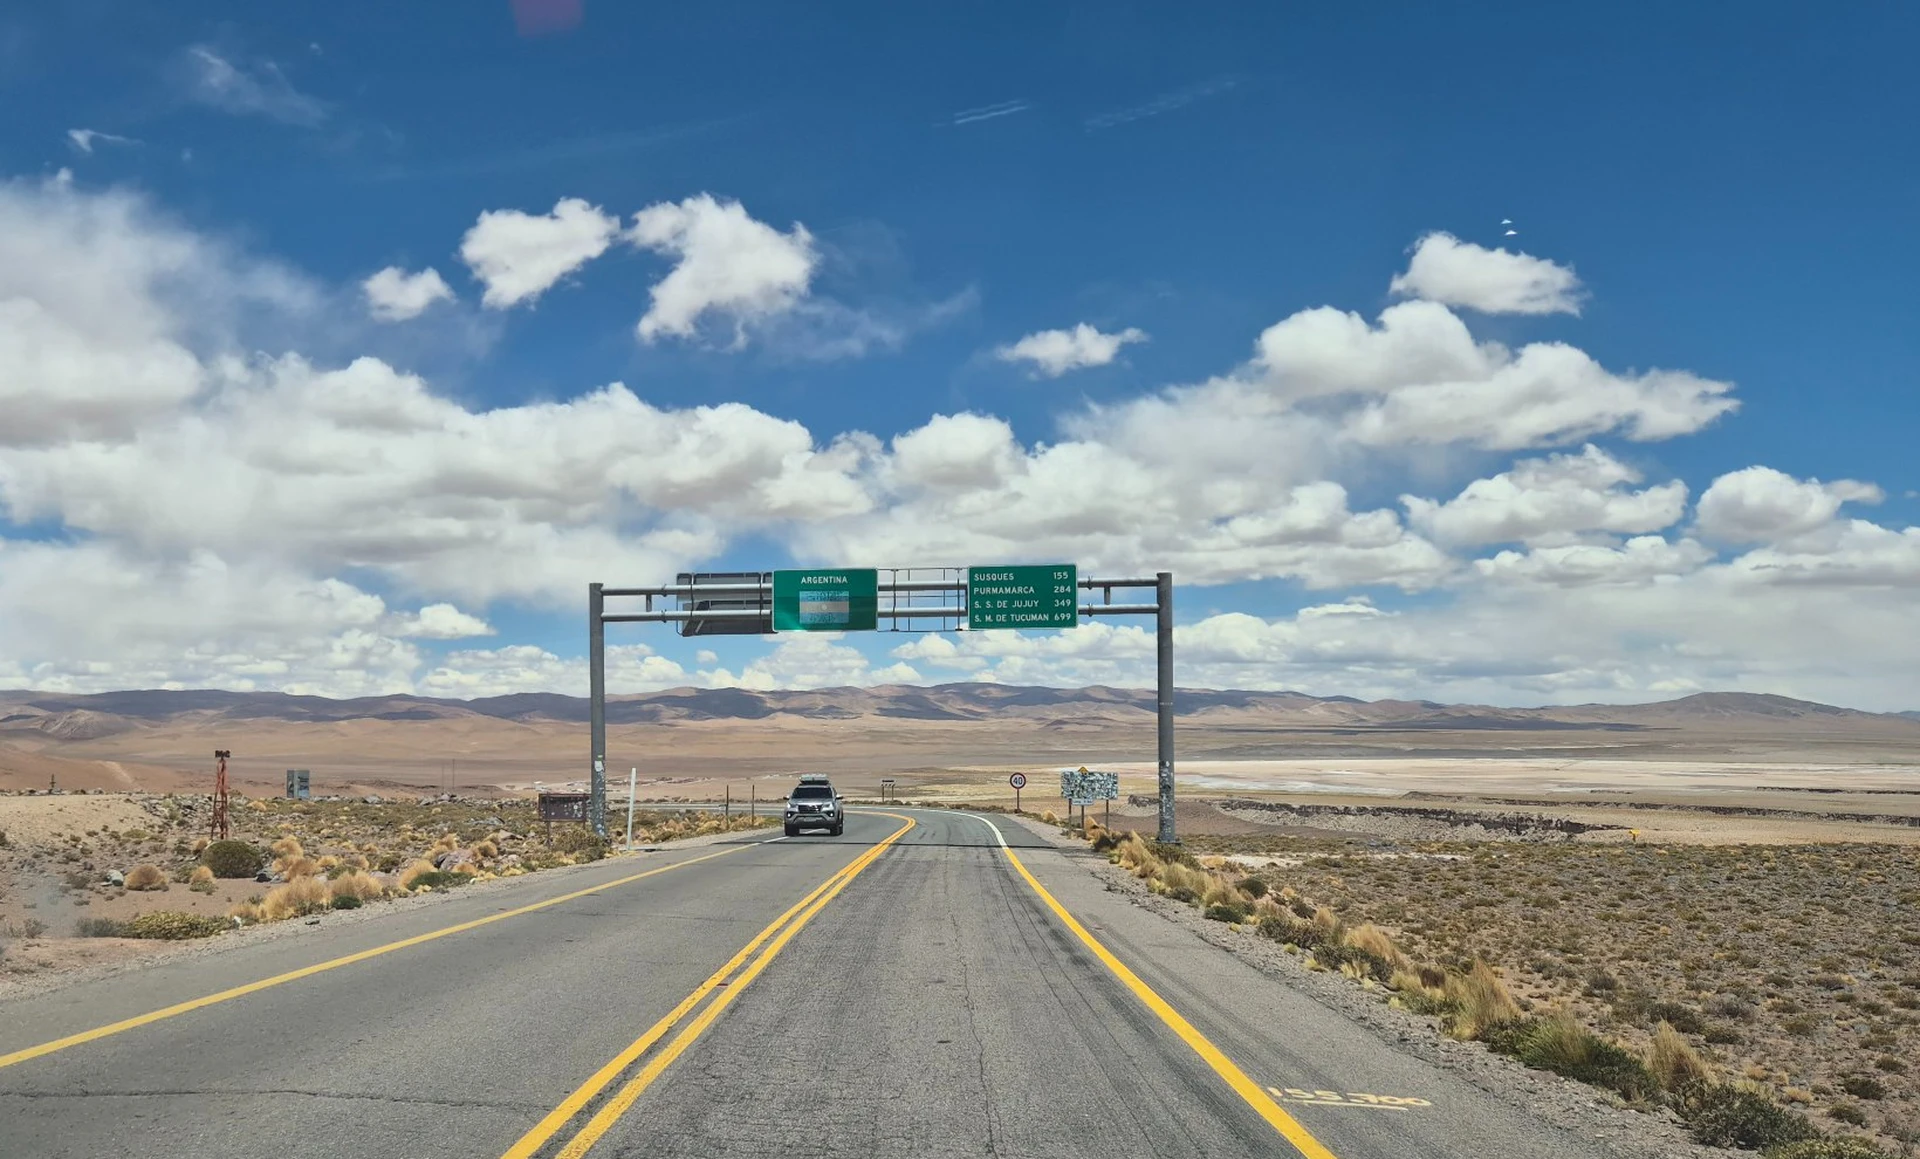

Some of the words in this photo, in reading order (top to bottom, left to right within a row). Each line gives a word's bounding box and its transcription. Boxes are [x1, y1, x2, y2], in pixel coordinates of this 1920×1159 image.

[801, 576, 848, 584] ARGENTINA
[974, 573, 1014, 581] SUSQUES
[1053, 572, 1068, 580] 155
[974, 586, 1034, 594] PURMAMARCA
[1053, 585, 1071, 593] 284
[985, 600, 993, 608] S.
[997, 600, 1008, 608] DE
[1012, 599, 1039, 608] JUJUY
[1054, 599, 1071, 607] 349
[996, 614, 1007, 622] DE
[1010, 613, 1049, 621] TUCUMAN
[1054, 613, 1071, 621] 699
[1013, 777, 1023, 785] 40
